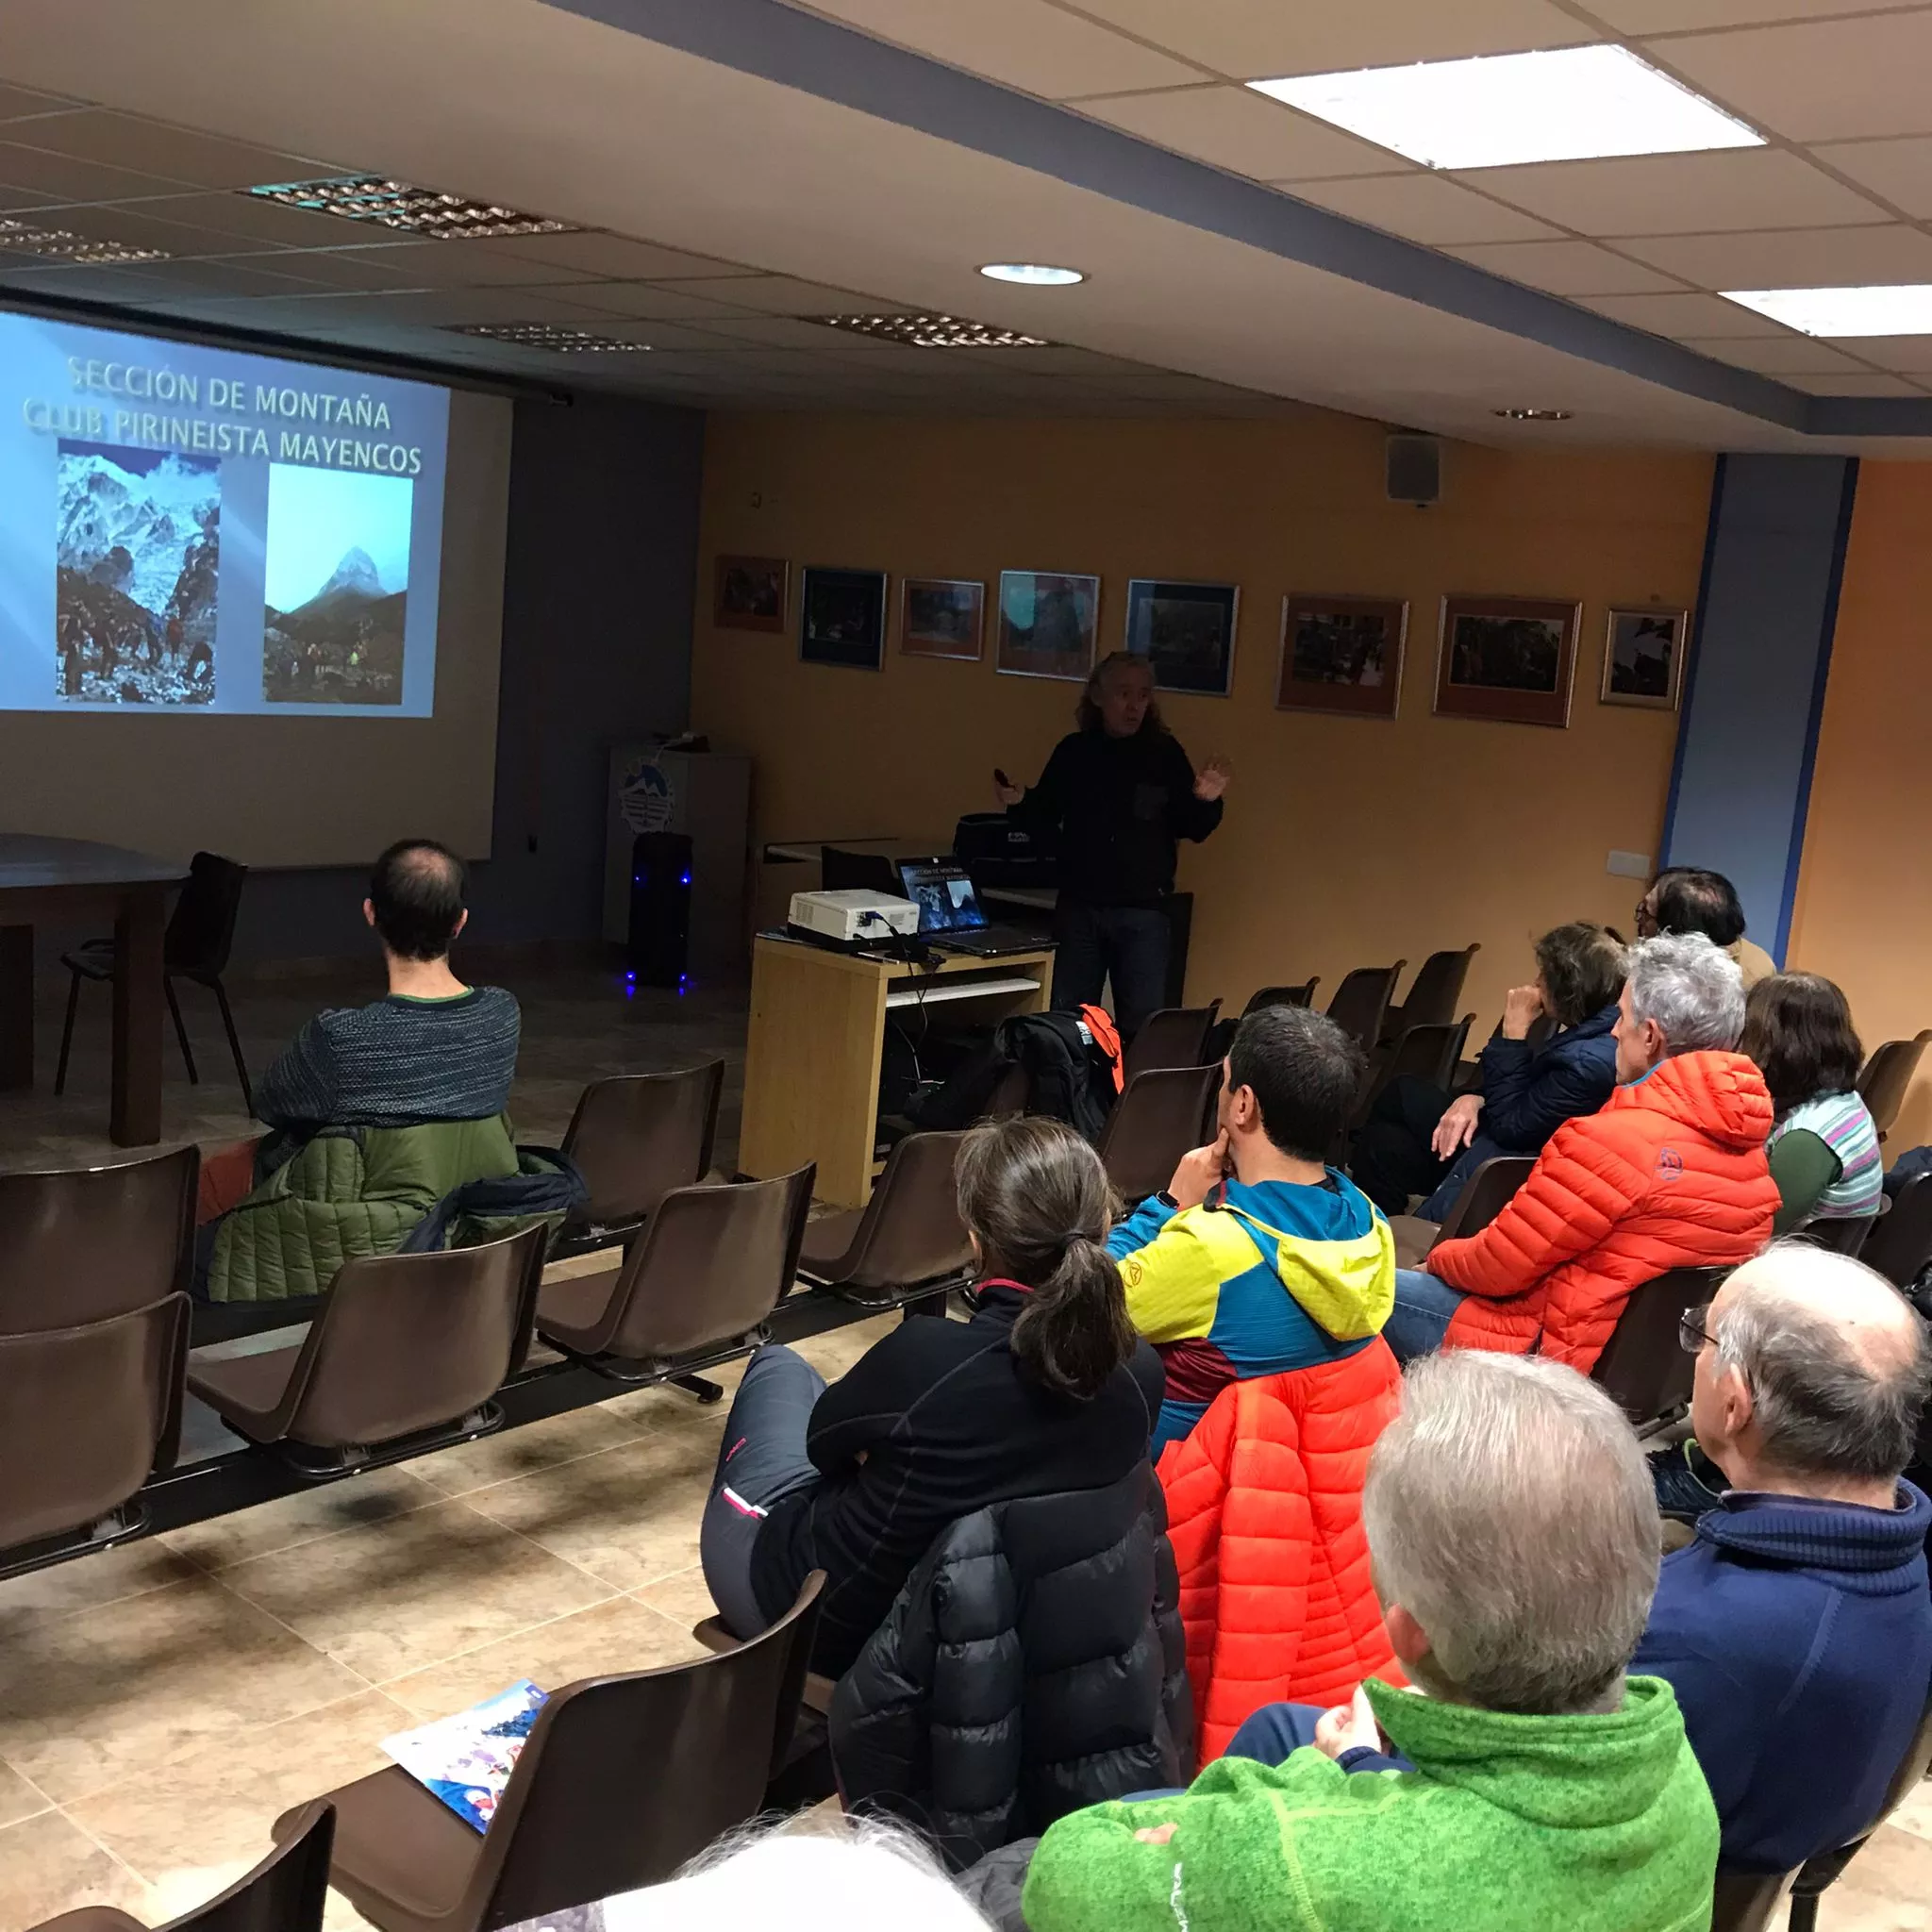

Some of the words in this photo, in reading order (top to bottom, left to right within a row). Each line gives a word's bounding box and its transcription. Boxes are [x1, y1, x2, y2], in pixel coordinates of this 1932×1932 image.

[67, 356, 198, 404] SECCIÓN
[209, 378, 246, 409] DE
[256, 385, 391, 430] MONTAÑA
[23, 397, 102, 434] CLUB
[115, 409, 270, 457] PIRINEISTA
[280, 431, 422, 474] MAYENCOS
